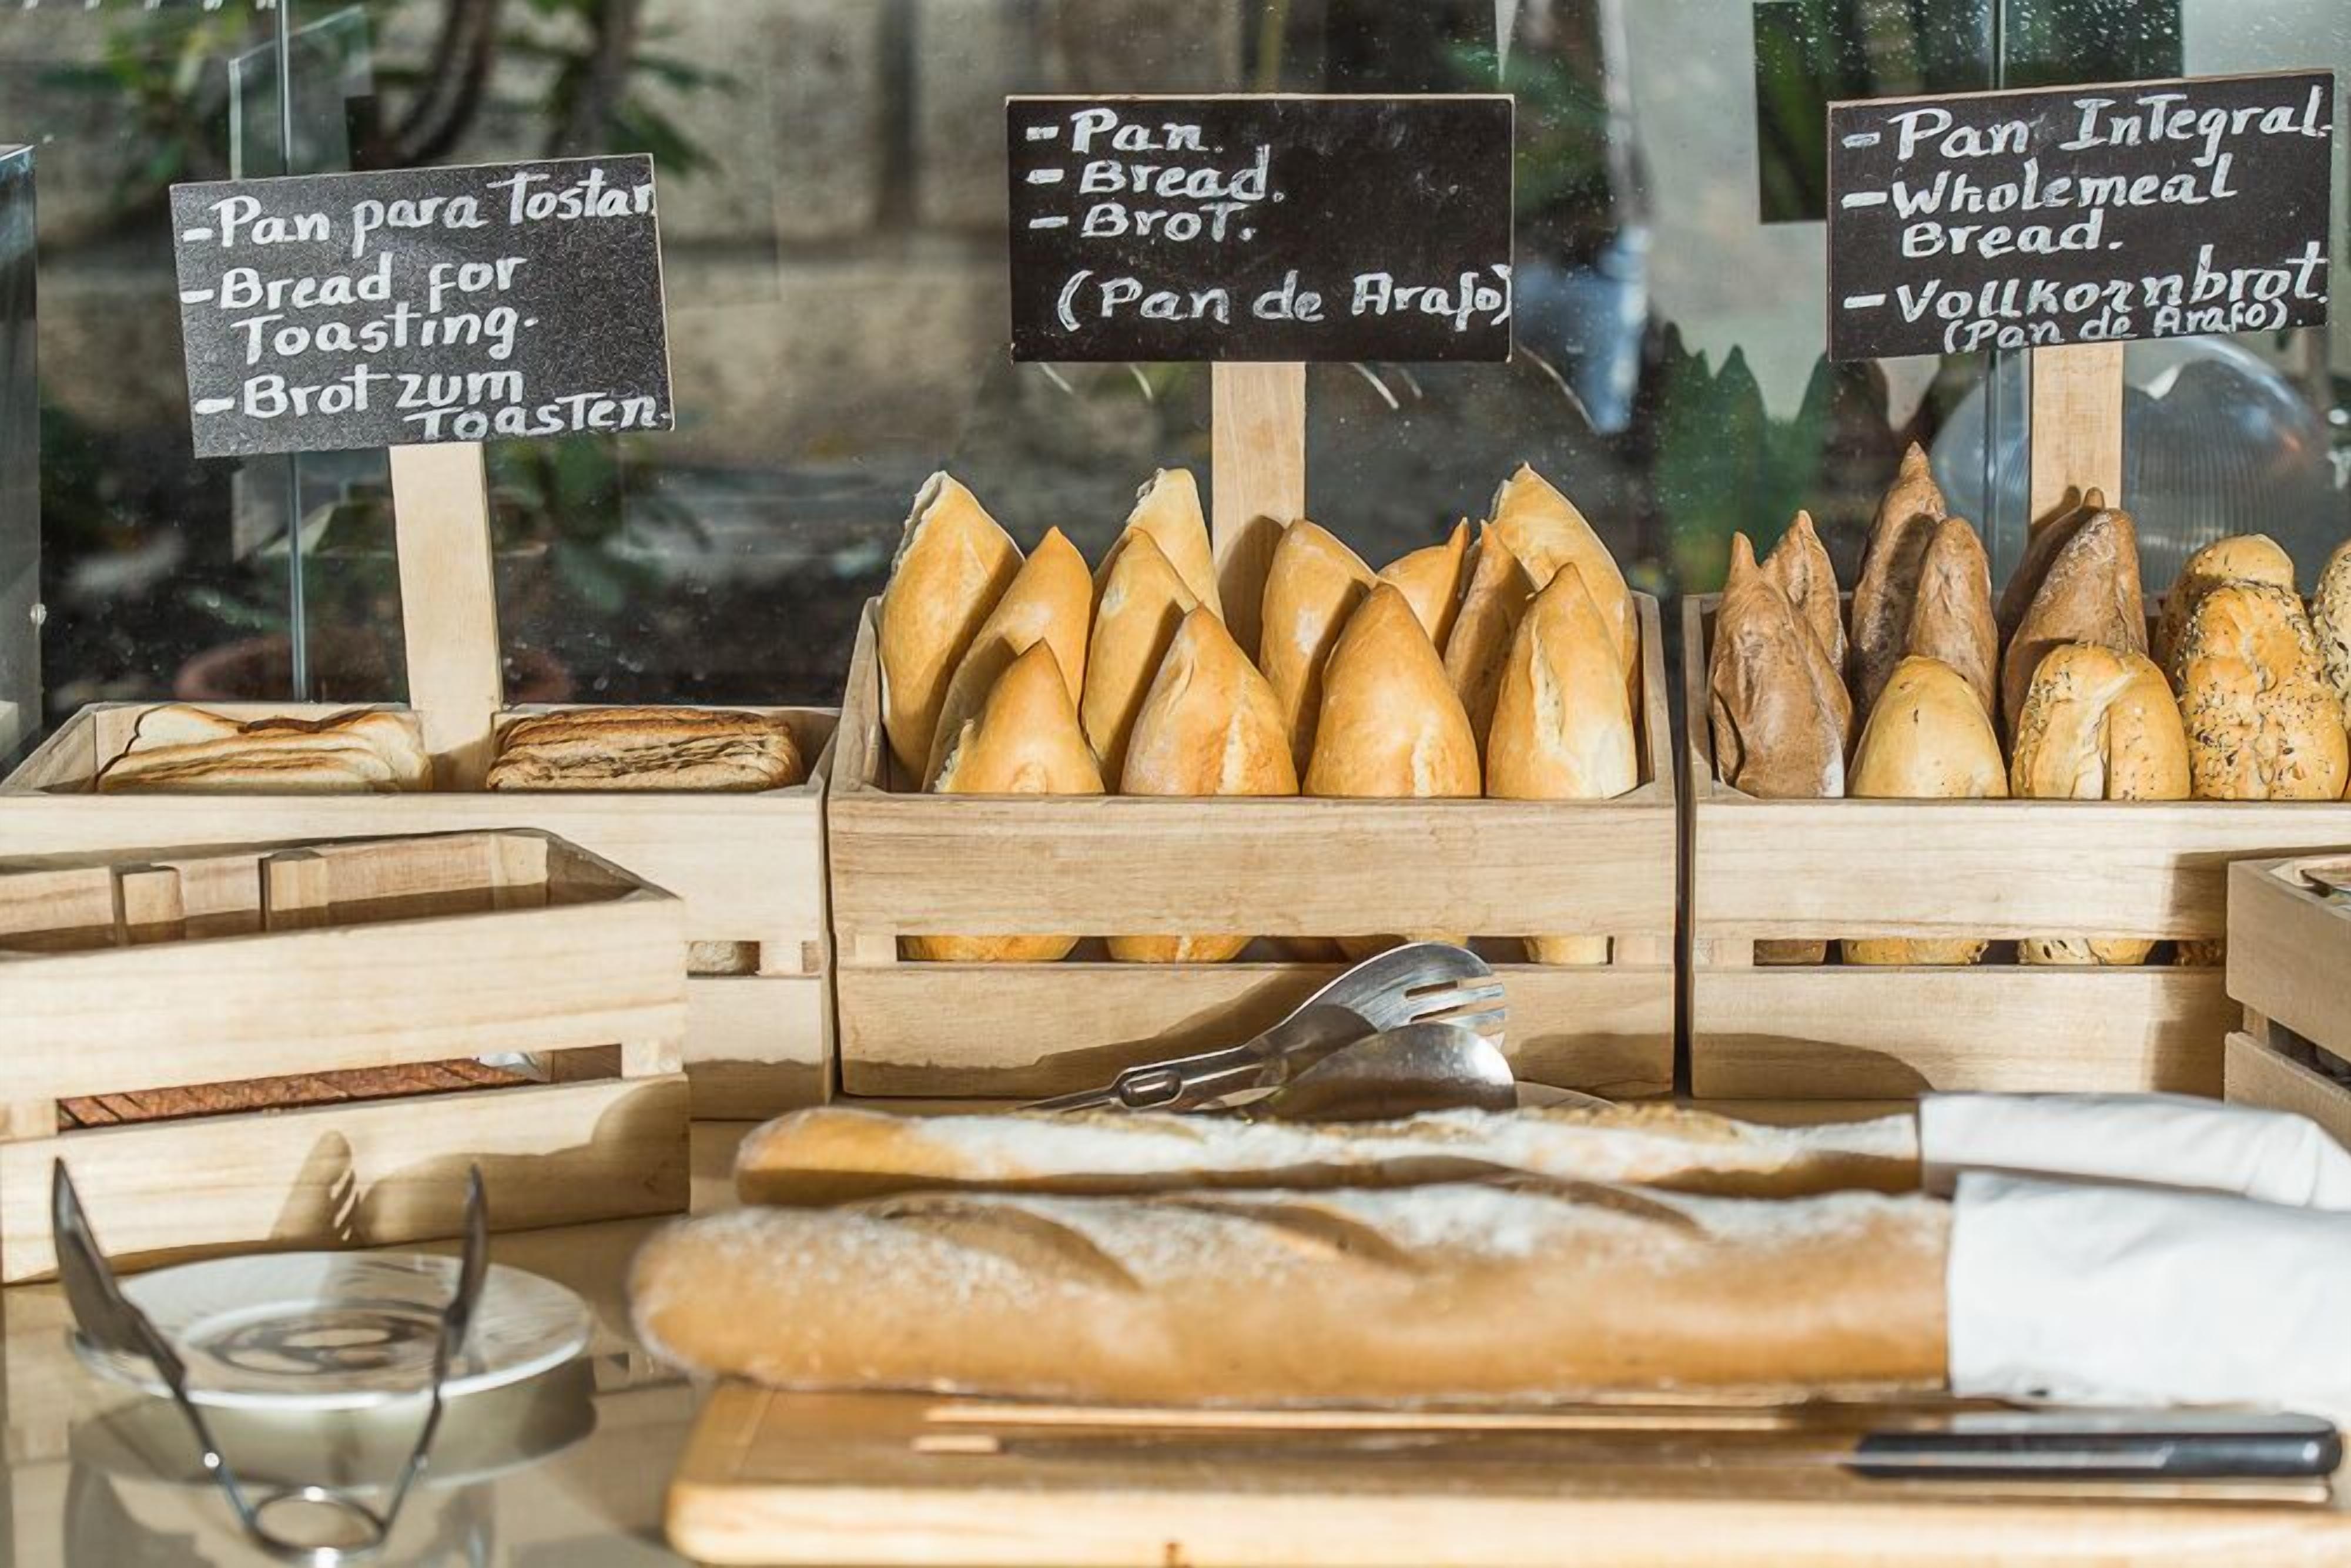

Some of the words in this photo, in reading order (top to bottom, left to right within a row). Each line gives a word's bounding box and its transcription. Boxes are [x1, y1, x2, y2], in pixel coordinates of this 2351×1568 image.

[353, 196, 488, 259] para
[487, 169, 657, 226] Tostar
[1901, 209, 2125, 259] Bread.
[428, 257, 527, 313] for
[1057, 269, 1231, 332] (Pan
[1252, 269, 1325, 323] de
[230, 302, 539, 366] Toasting.
[1944, 320, 2067, 354] (Pan
[2078, 305, 2137, 341] de
[395, 371, 525, 408] zum
